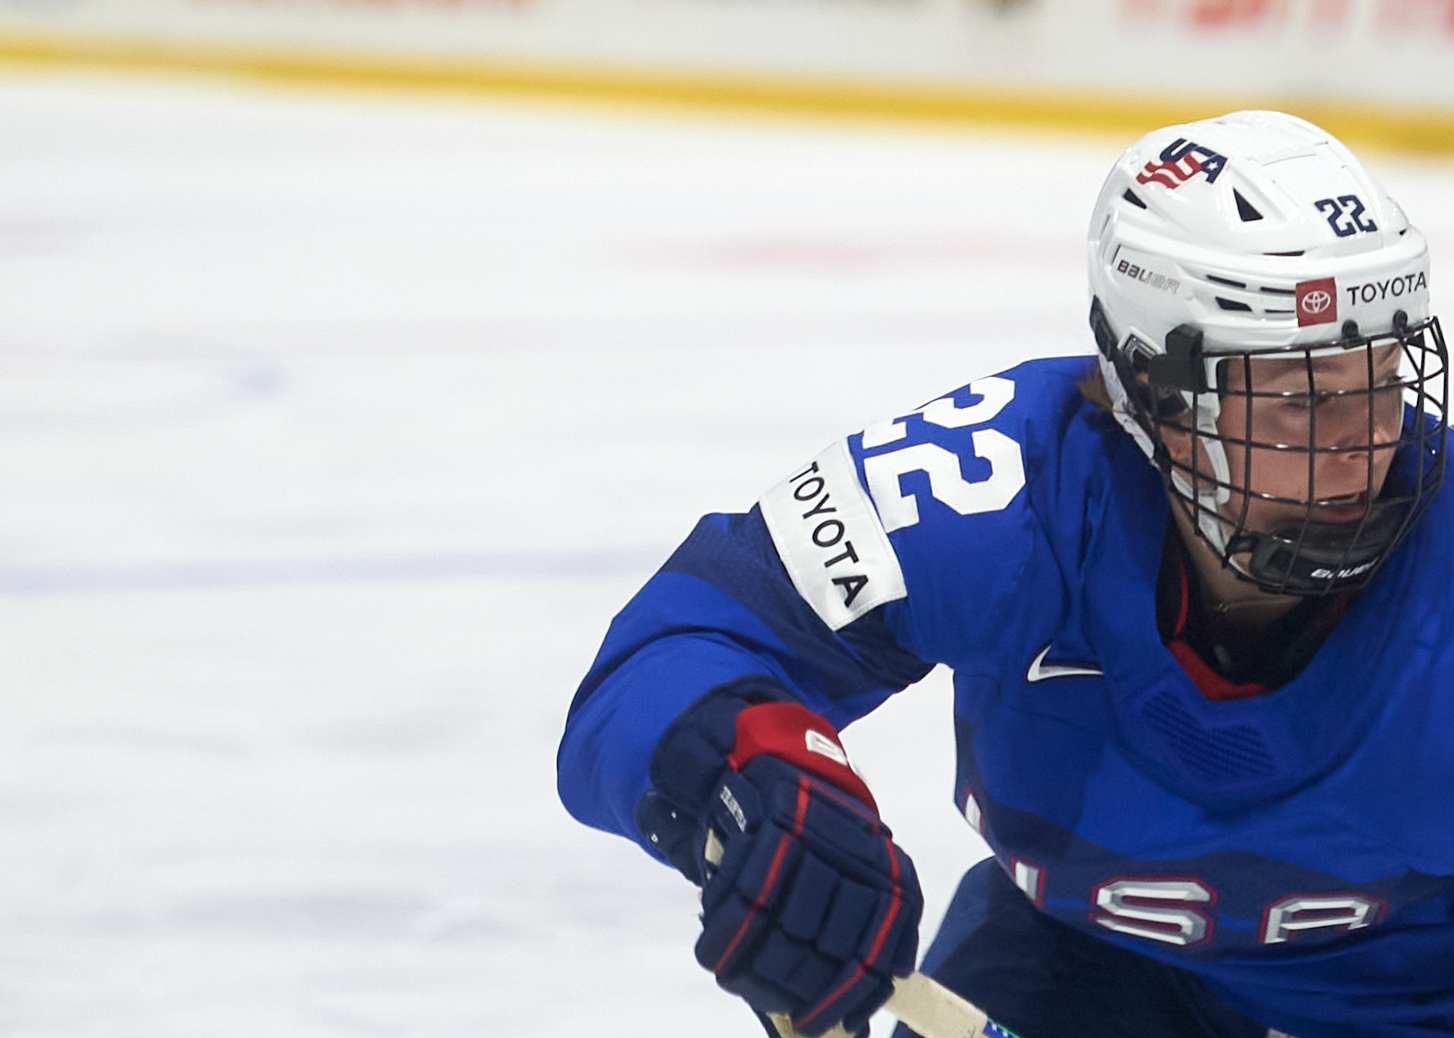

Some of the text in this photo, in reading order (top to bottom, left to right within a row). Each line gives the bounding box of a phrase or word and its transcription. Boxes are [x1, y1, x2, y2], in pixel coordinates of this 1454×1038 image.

[1135, 137, 1229, 190] USA
[1314, 194, 1378, 238] 22
[1117, 259, 1181, 294] BAUER
[1346, 271, 1427, 306] TOYOTA
[788, 460, 869, 608] TOYOTA
